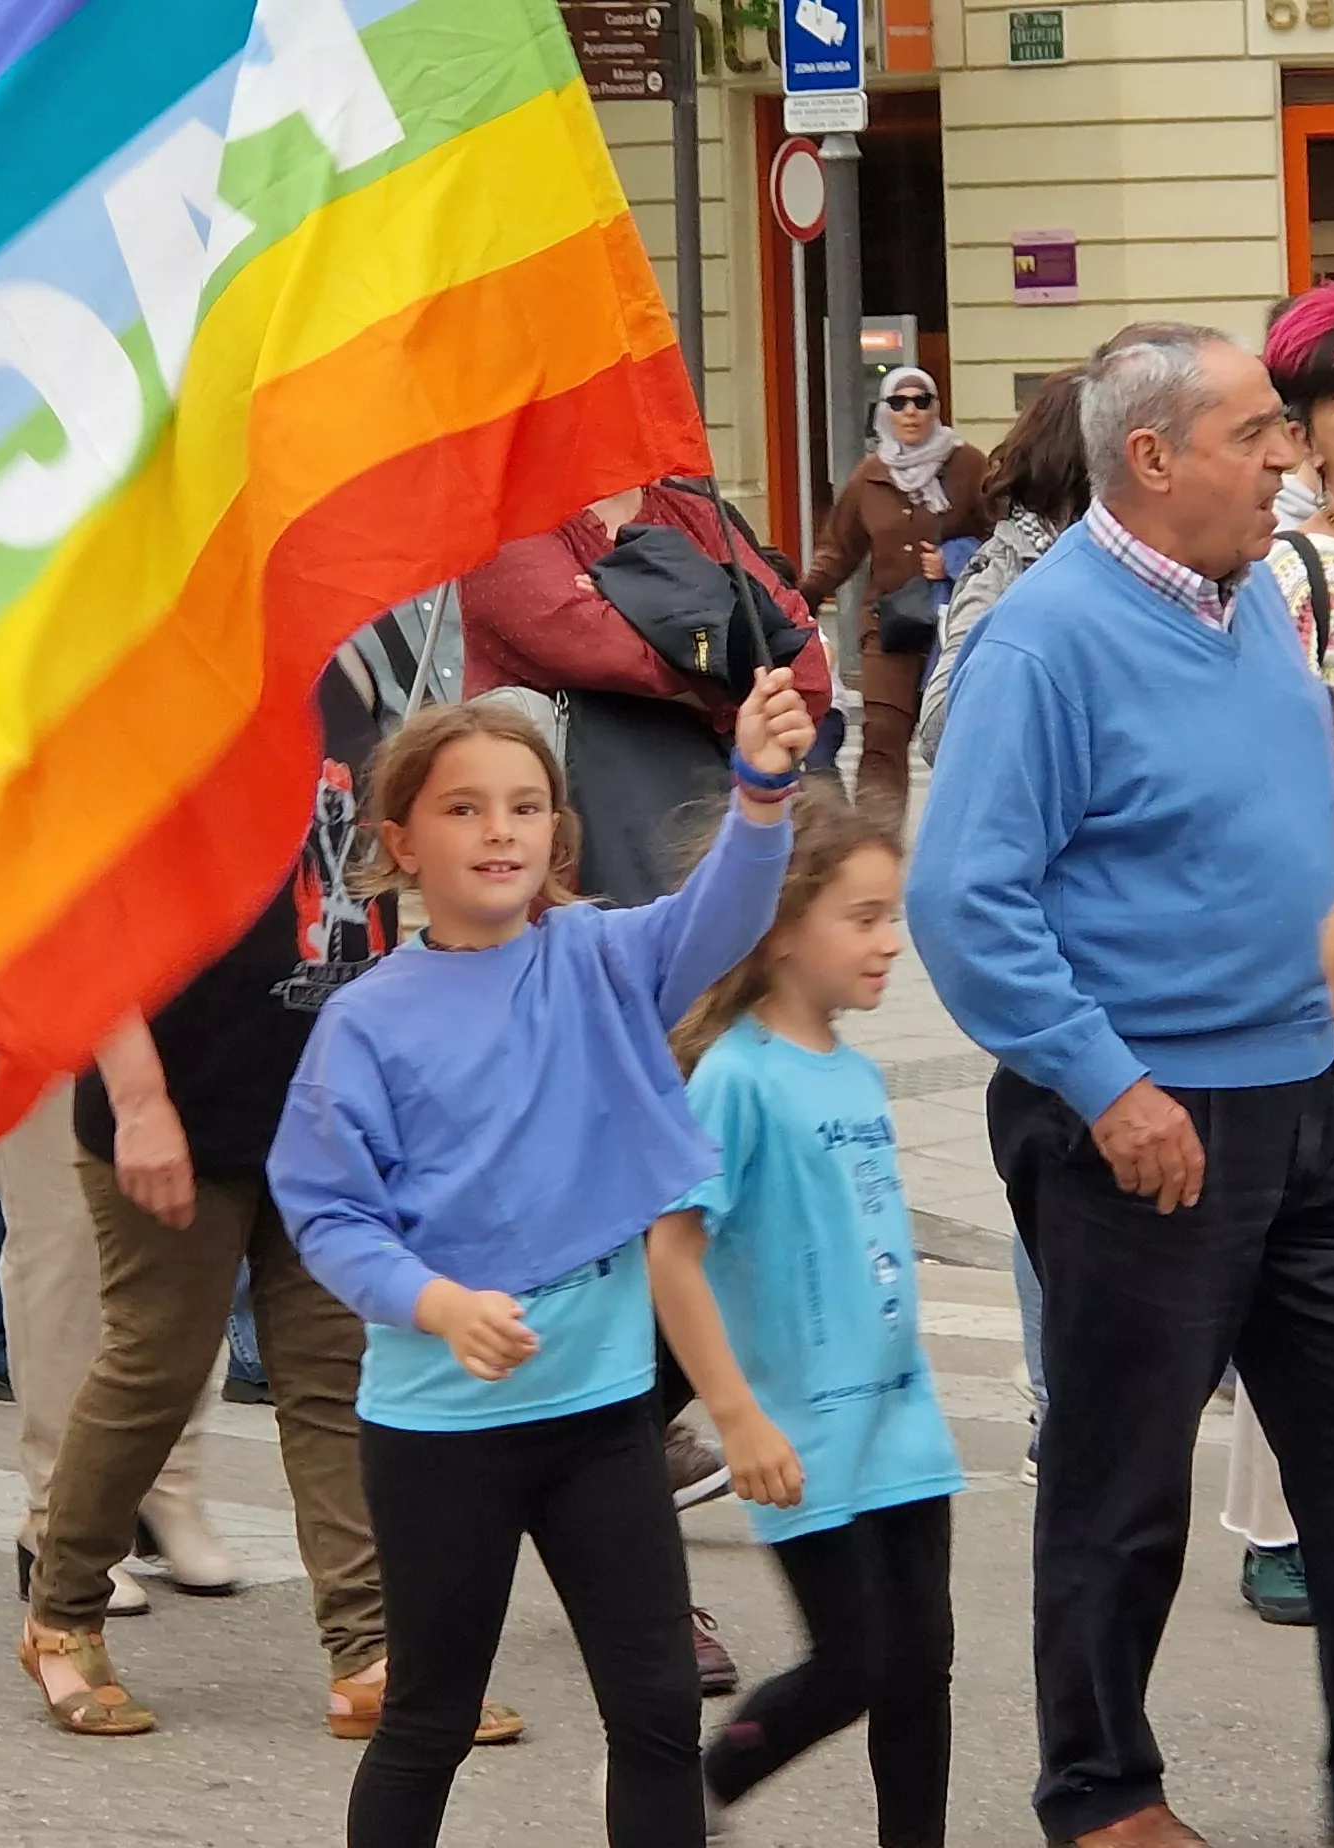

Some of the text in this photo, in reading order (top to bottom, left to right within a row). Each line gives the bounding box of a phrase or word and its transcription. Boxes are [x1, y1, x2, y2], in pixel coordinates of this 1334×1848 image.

[604, 12, 645, 26] Catedral
[582, 40, 646, 57] Ayuntamiento
[612, 67, 645, 81] Museo
[793, 60, 852, 75] ZONA VIGILADA
